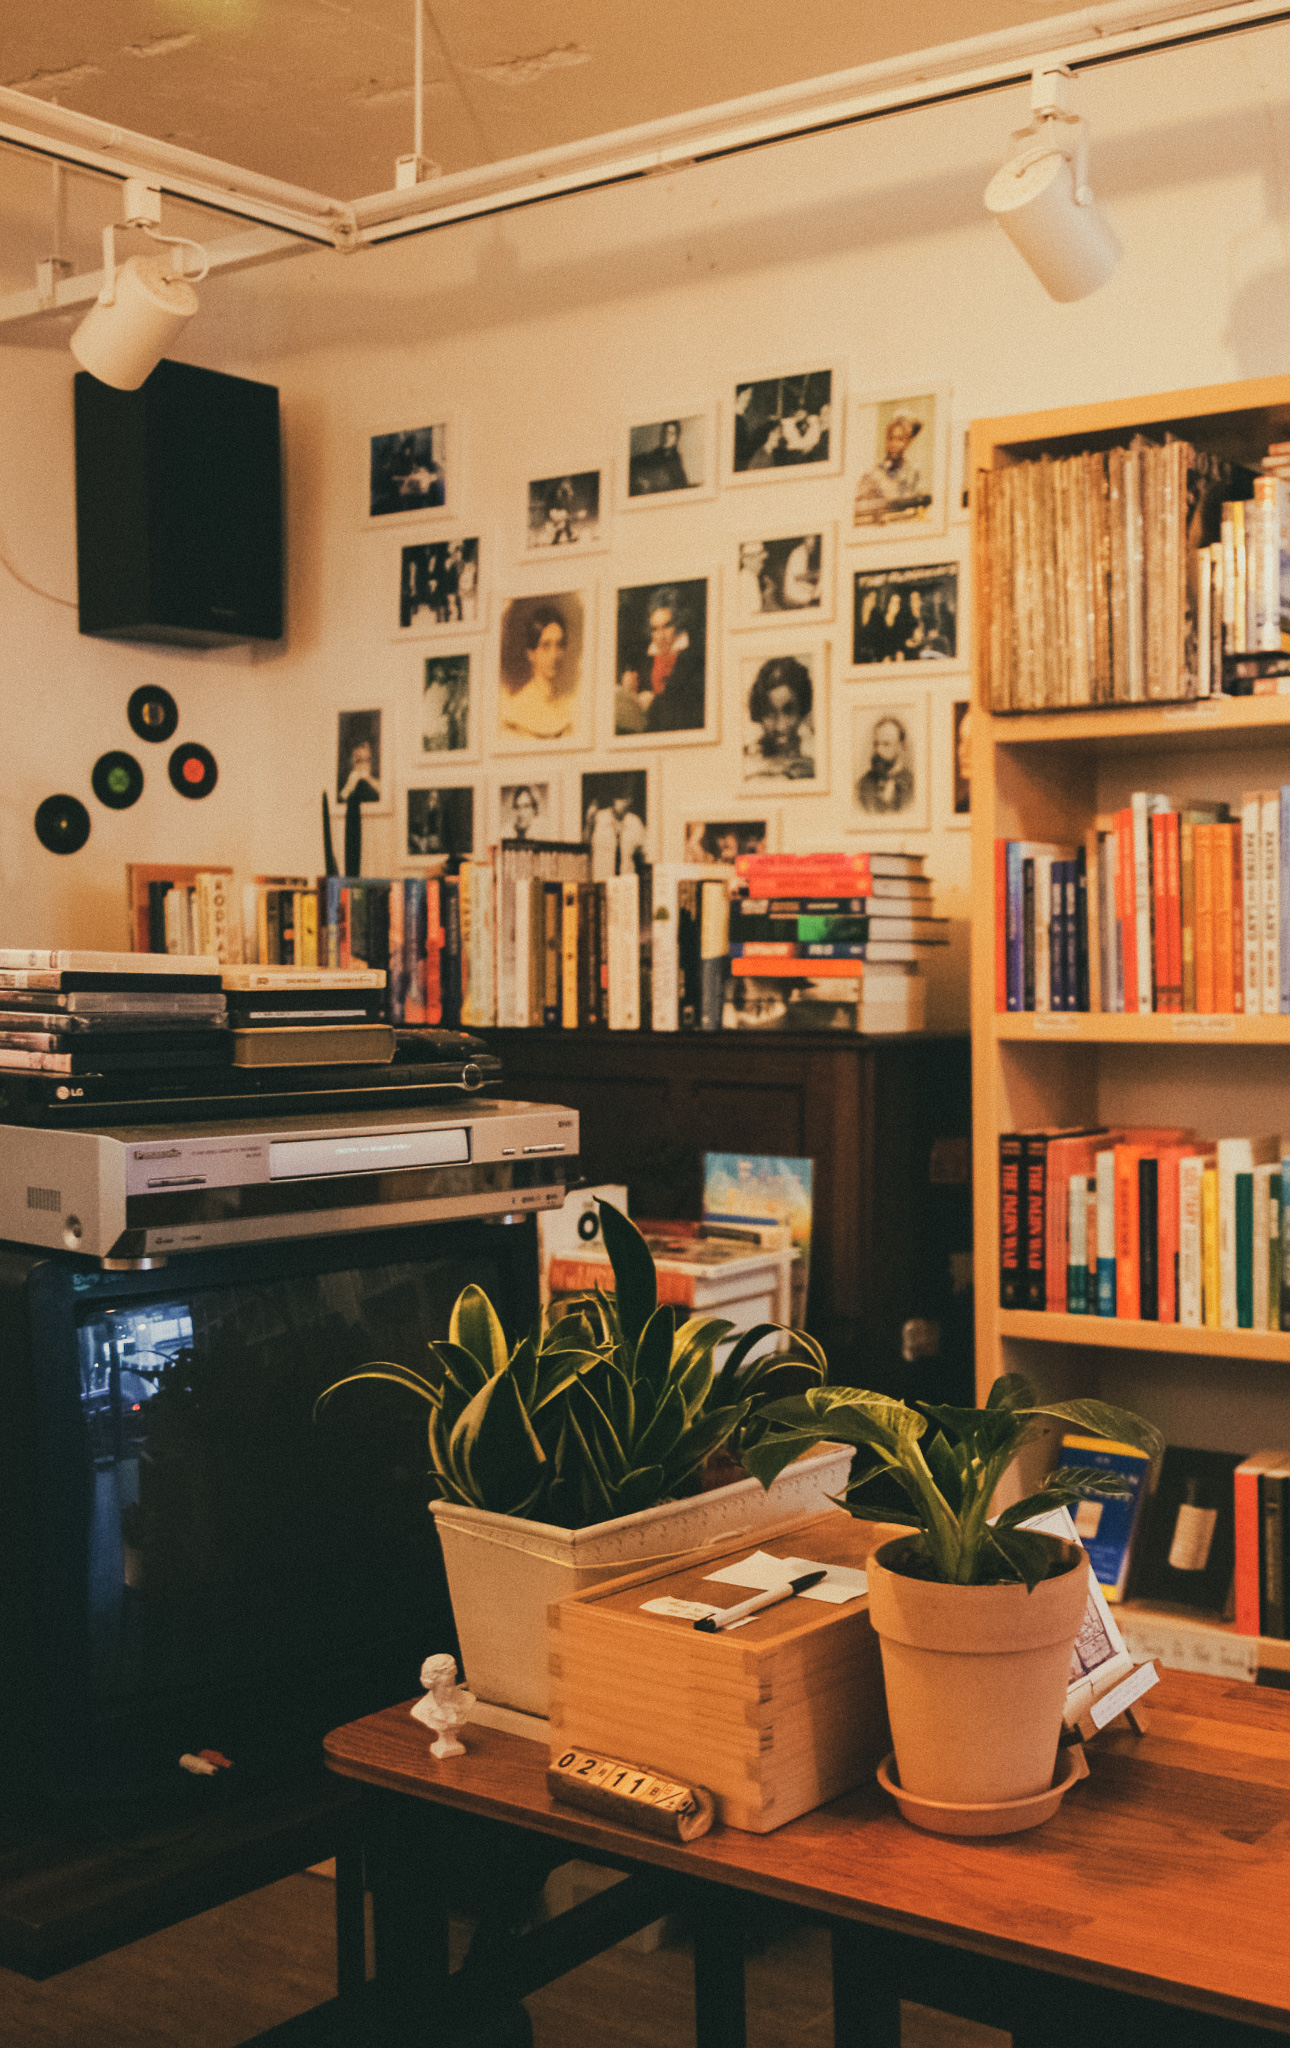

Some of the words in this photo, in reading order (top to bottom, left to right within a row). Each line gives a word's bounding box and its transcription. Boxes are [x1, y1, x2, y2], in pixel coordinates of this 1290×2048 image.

[70, 1087, 84, 1097] LG
[1002, 1164, 1018, 1190] THE
[1028, 1165, 1043, 1191] THE
[1003, 1236, 1017, 1268] WAR
[1029, 1238, 1042, 1269] WAR
